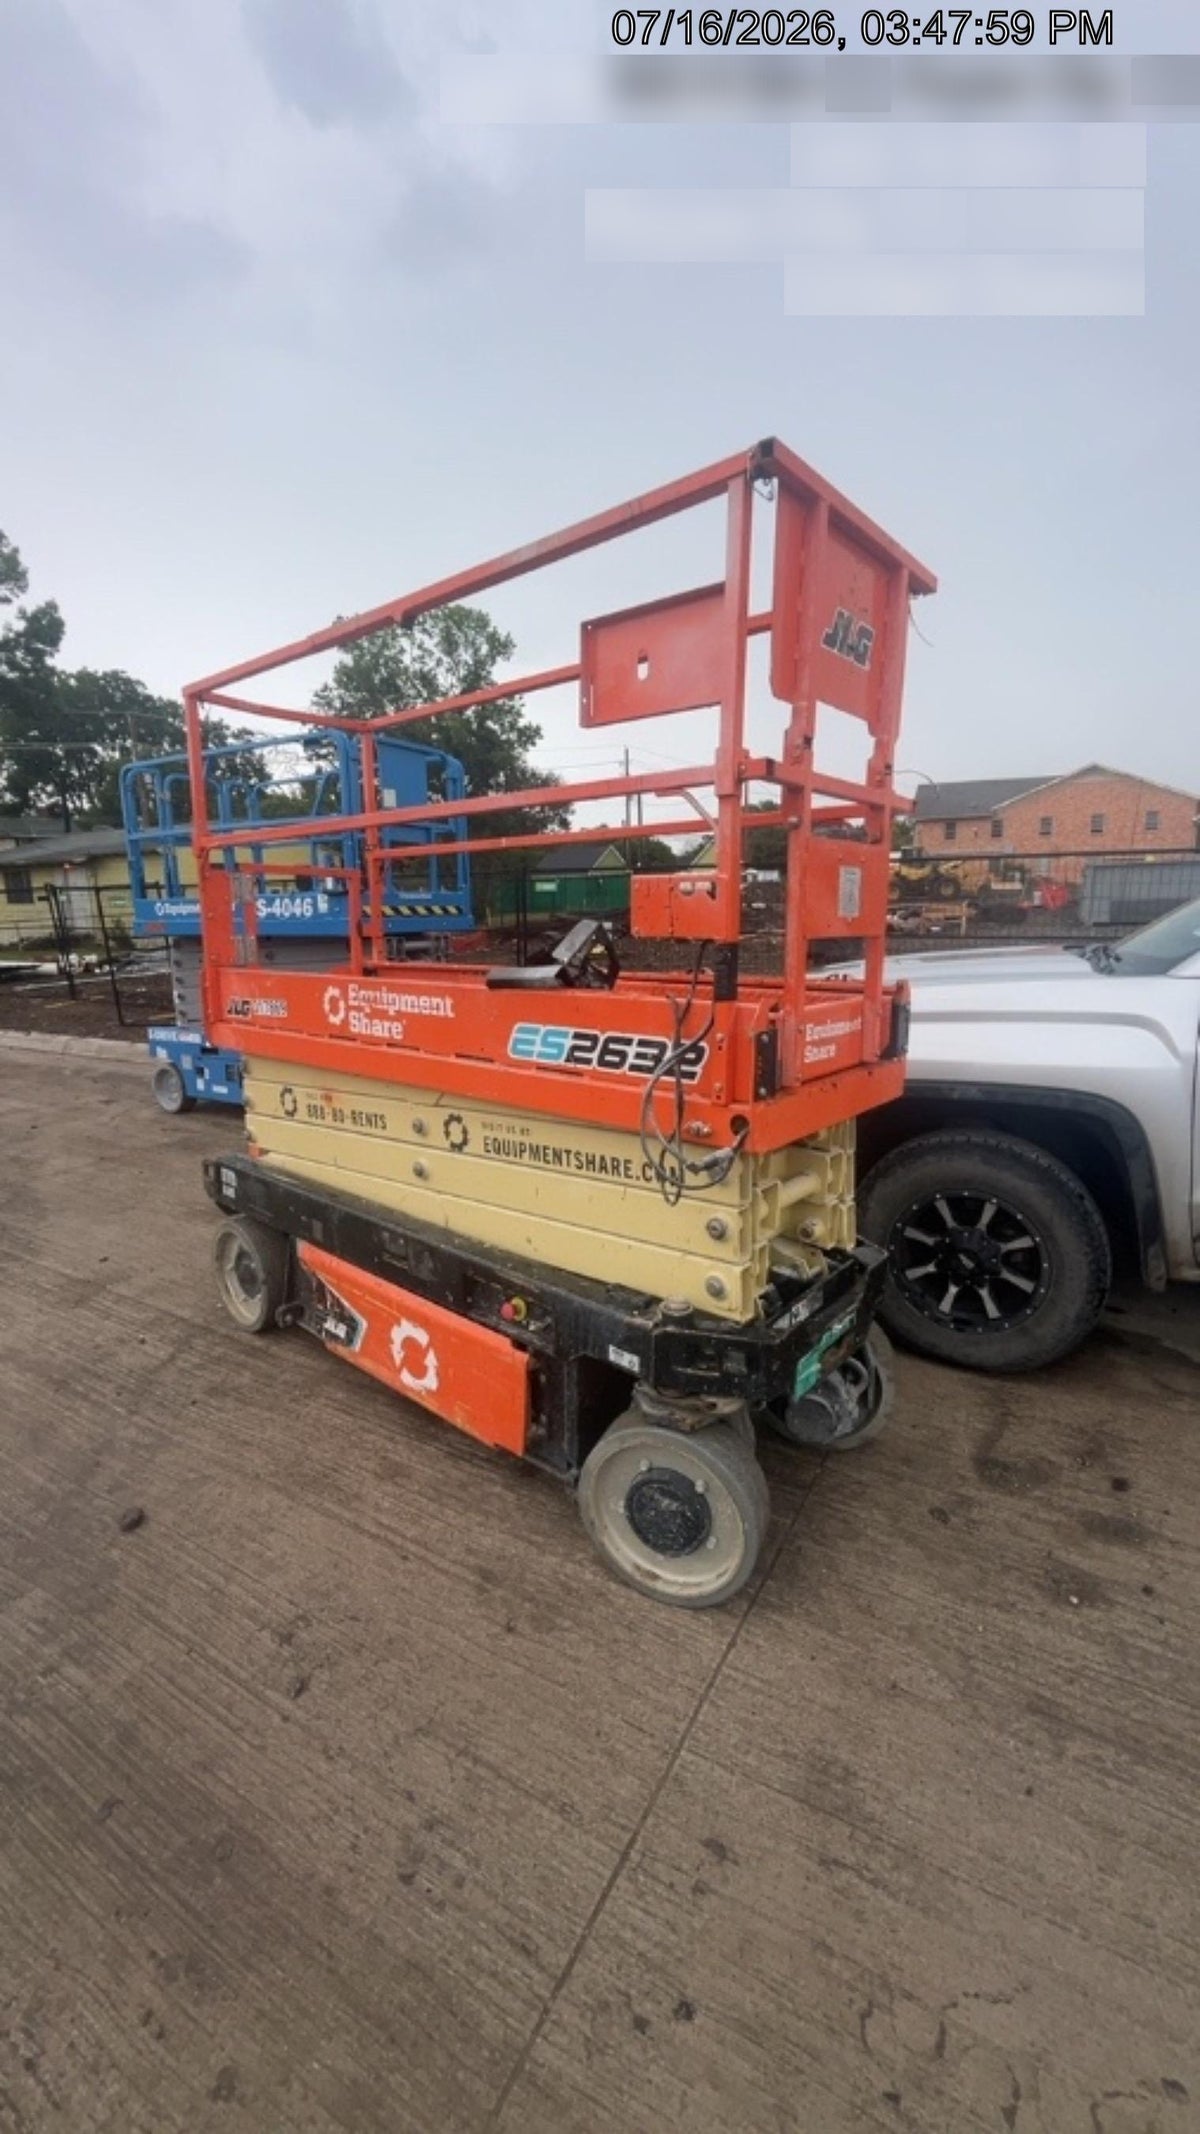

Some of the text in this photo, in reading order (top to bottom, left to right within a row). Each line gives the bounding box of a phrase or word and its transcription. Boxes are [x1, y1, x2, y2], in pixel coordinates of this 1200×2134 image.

[821, 607, 875, 670] JLG
[256, 898, 313, 918] S-4046
[347, 984, 455, 1018] Equipment
[348, 1011, 403, 1039] Share
[509, 1023, 708, 1083] ES2632
[804, 1043, 836, 1063] Share
